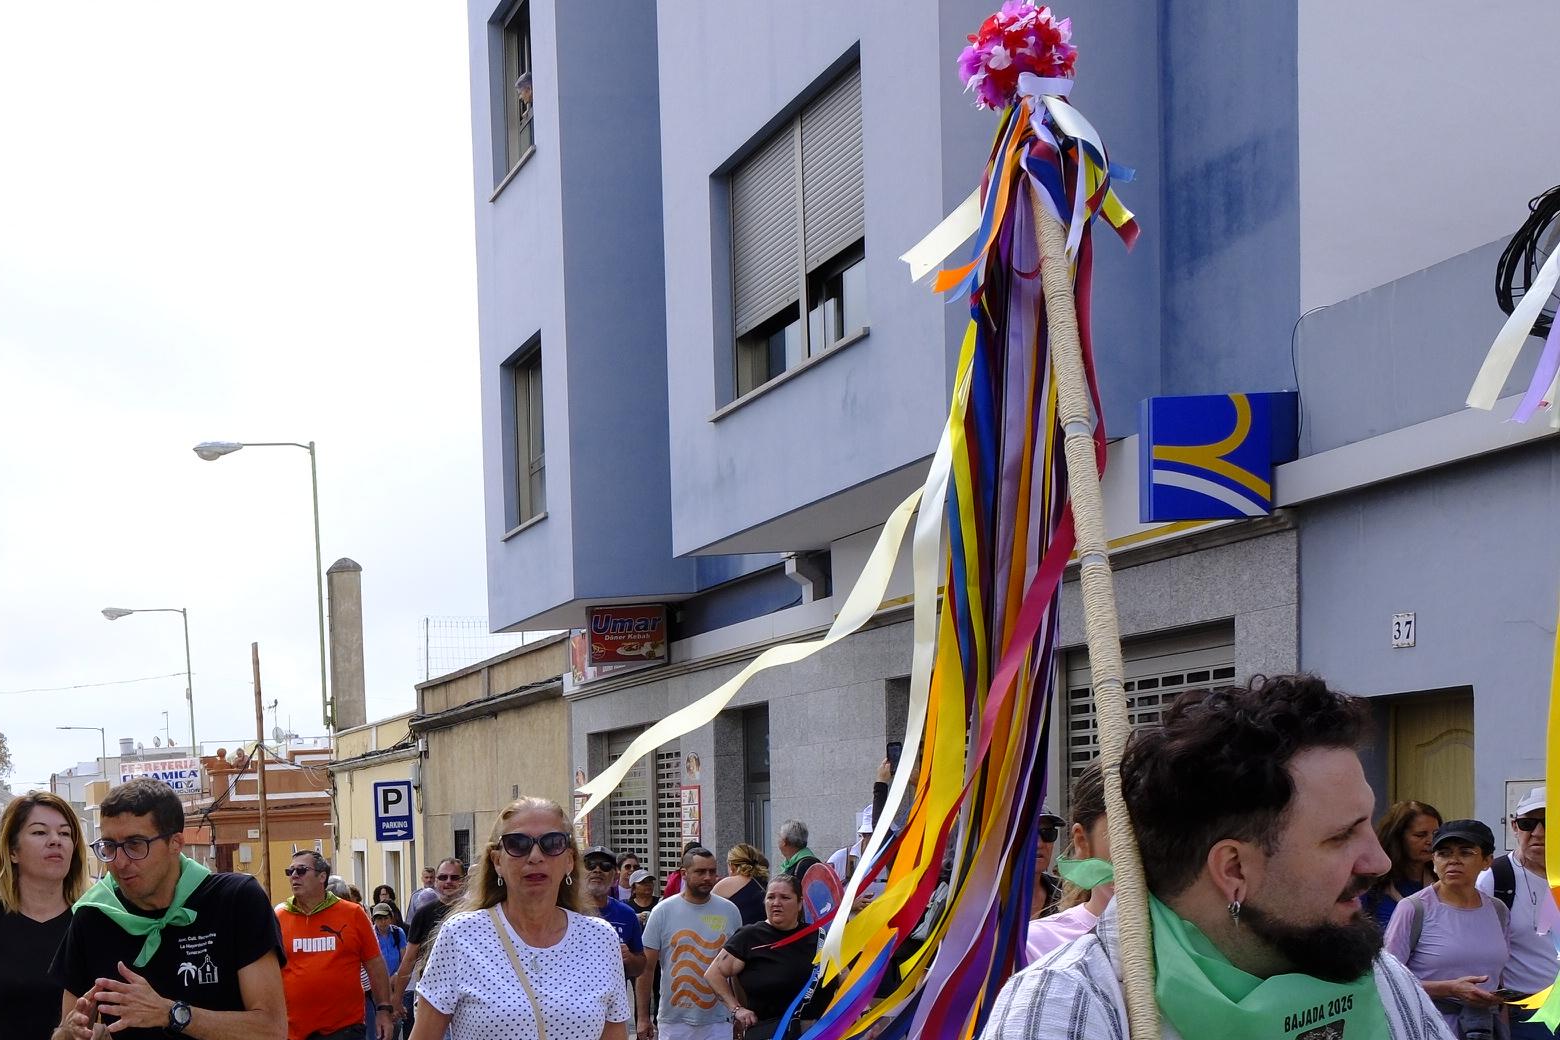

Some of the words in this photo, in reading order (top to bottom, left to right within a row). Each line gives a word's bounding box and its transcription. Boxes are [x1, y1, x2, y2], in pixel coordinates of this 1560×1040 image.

[591, 614, 662, 634] Umar
[1393, 620, 1412, 640] 37
[383, 789, 402, 814] P
[382, 821, 408, 829] PARKING
[293, 936, 336, 953] PUMA
[1284, 1004, 1325, 1033] BAJADA
[1328, 994, 1354, 1018] 2025
